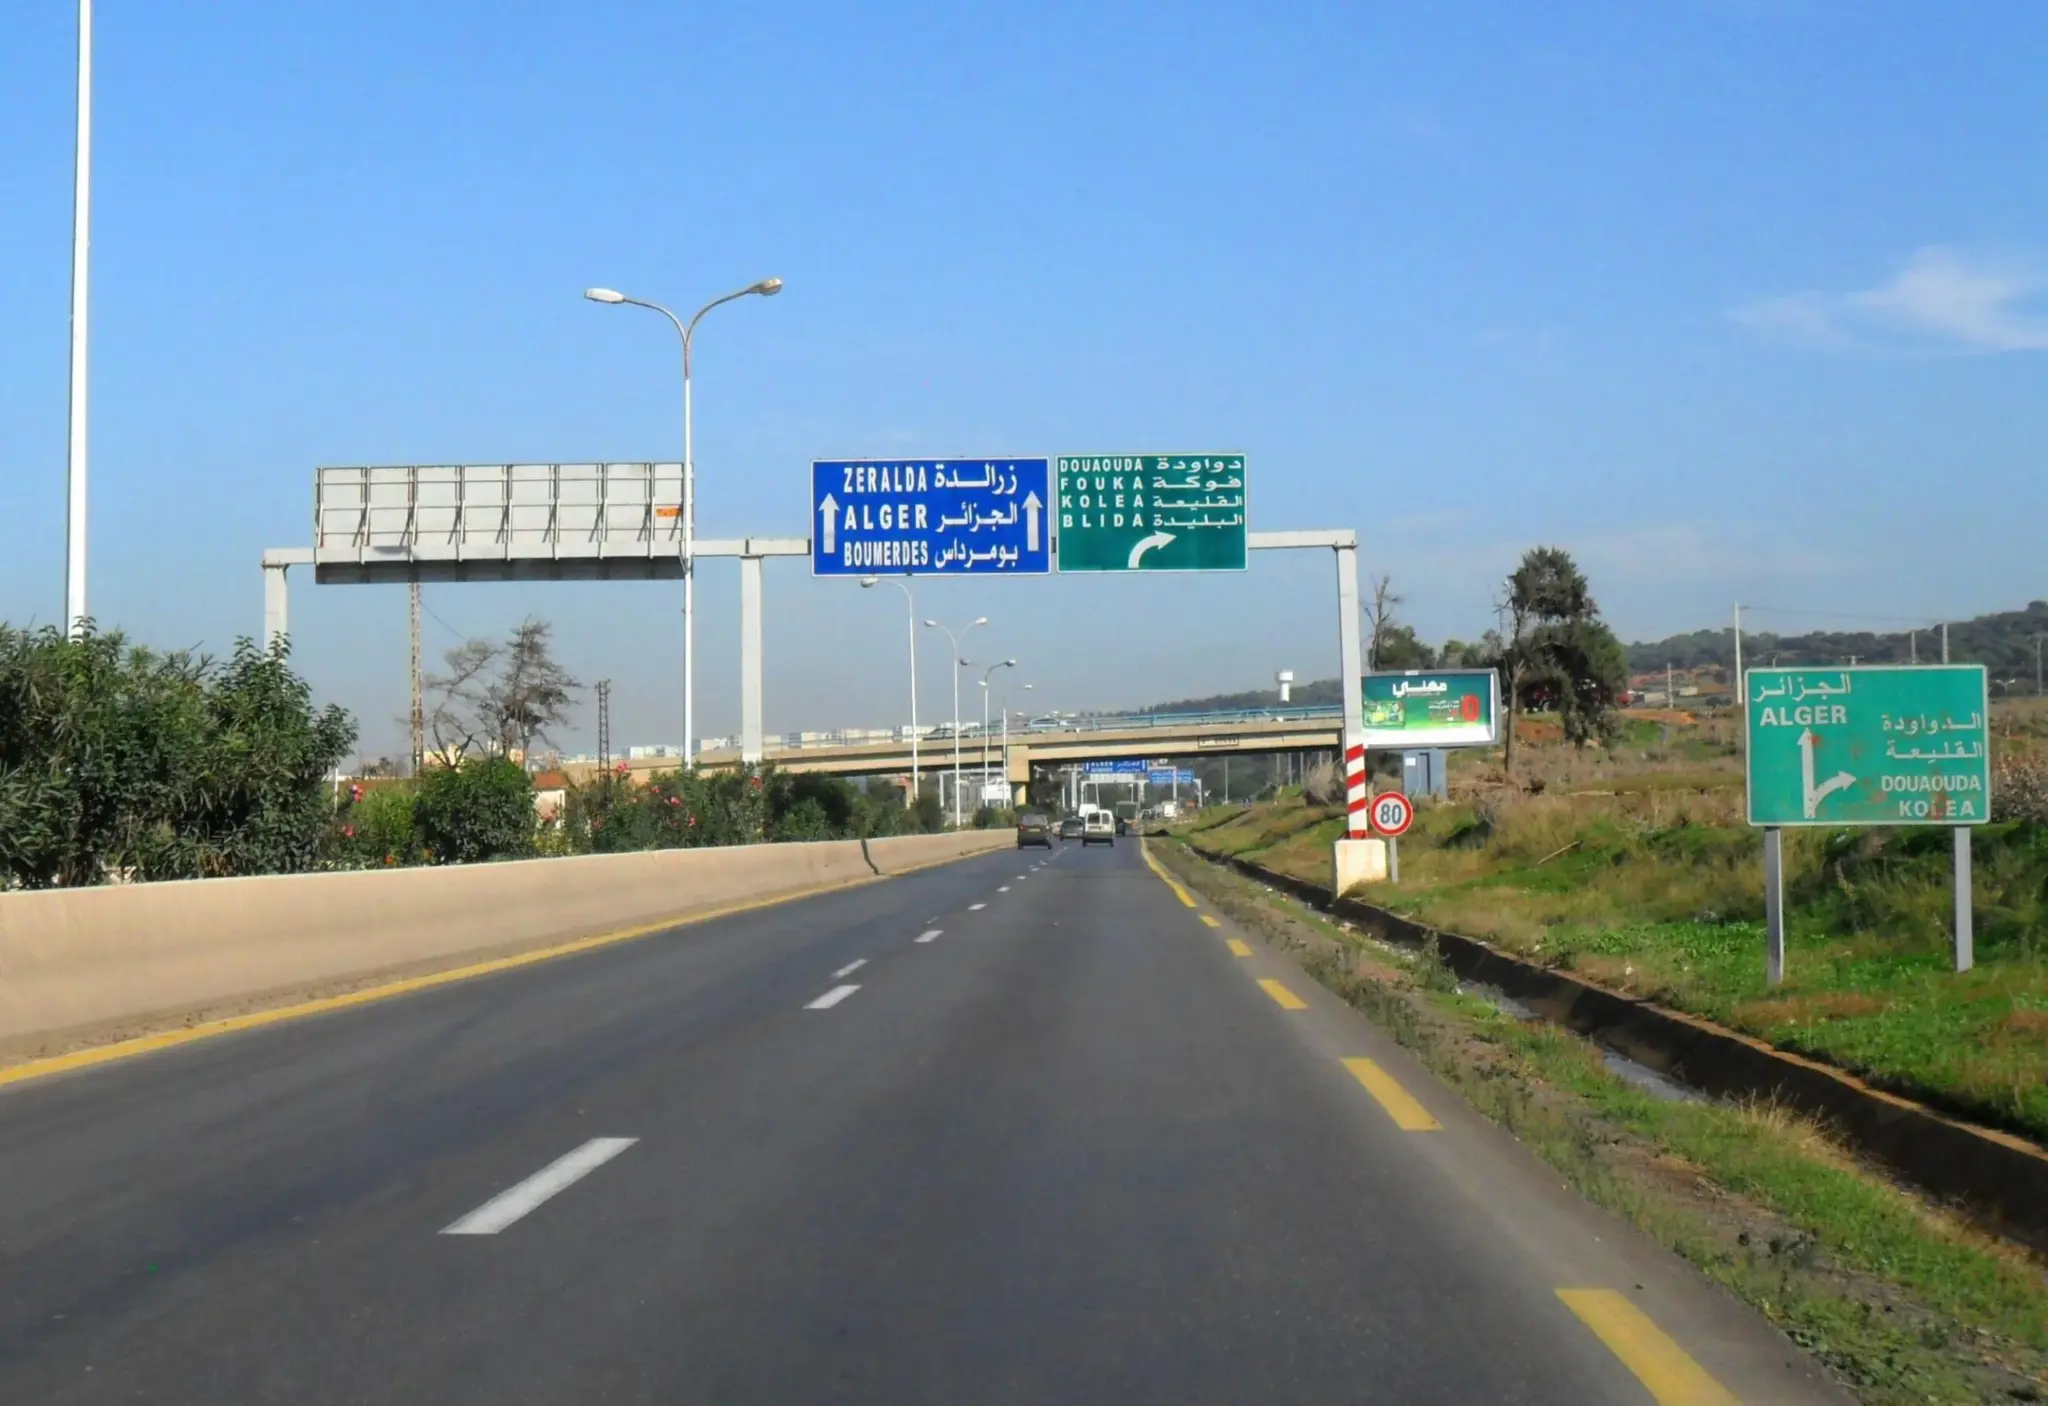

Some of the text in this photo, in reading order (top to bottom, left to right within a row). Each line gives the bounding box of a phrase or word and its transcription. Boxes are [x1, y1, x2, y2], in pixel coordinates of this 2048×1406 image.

[1060, 458, 1144, 472] DOUAOUDA
[1156, 457, 1242, 473] دواودة
[843, 466, 928, 493] ZERALDA
[934, 462, 1018, 495] زرالدة
[1060, 476, 1144, 491] FOUKA
[1152, 475, 1242, 491] فوكة
[1061, 494, 1144, 508] KOLEA
[1152, 494, 1243, 511] القليعة
[844, 503, 928, 530] ALGER
[935, 501, 1018, 532] الجزائر
[1062, 514, 1144, 528] BLIDA
[1153, 513, 1243, 529] البليدة
[843, 540, 929, 567] BOUMERDES
[934, 537, 1019, 568] بومرداس
[1752, 671, 1852, 702] الجزائر
[1759, 704, 1848, 727] ALGER
[1881, 711, 1982, 736] الدواودة
[1885, 738, 1983, 765] القليعة
[1881, 774, 1983, 792] DOUAOUDA
[1380, 803, 1402, 825] 80
[1899, 798, 1976, 818] KOLEA
